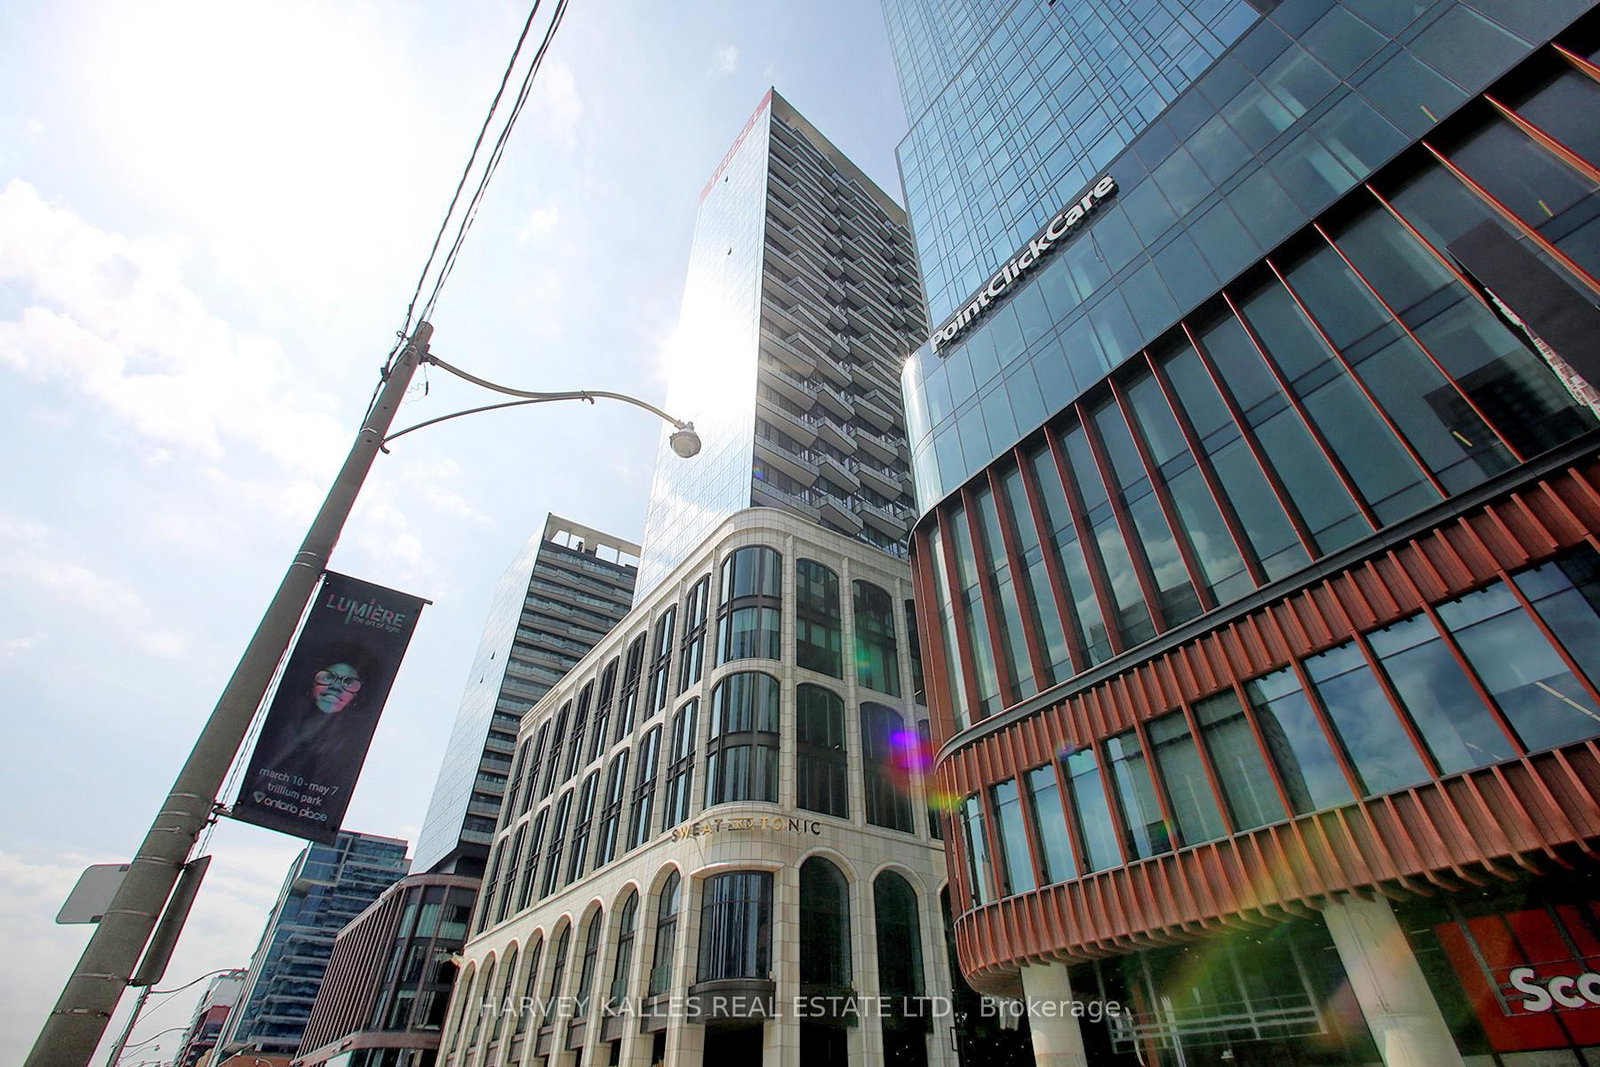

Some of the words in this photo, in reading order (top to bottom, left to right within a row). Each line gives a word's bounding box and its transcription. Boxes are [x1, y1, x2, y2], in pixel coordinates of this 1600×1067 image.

[930, 174, 1117, 354] PointClickCare
[326, 594, 405, 627] LUMIÈRE
[259, 768, 290, 782] march
[292, 775, 304, 787] 10
[308, 782, 331, 796] may
[331, 786, 339, 796] 7
[267, 783, 300, 799] trillium
[300, 794, 323, 807] park
[264, 797, 299, 814] ontario
[299, 807, 328, 822] place
[671, 818, 724, 843] SWEAT
[760, 815, 822, 836] TONIC
